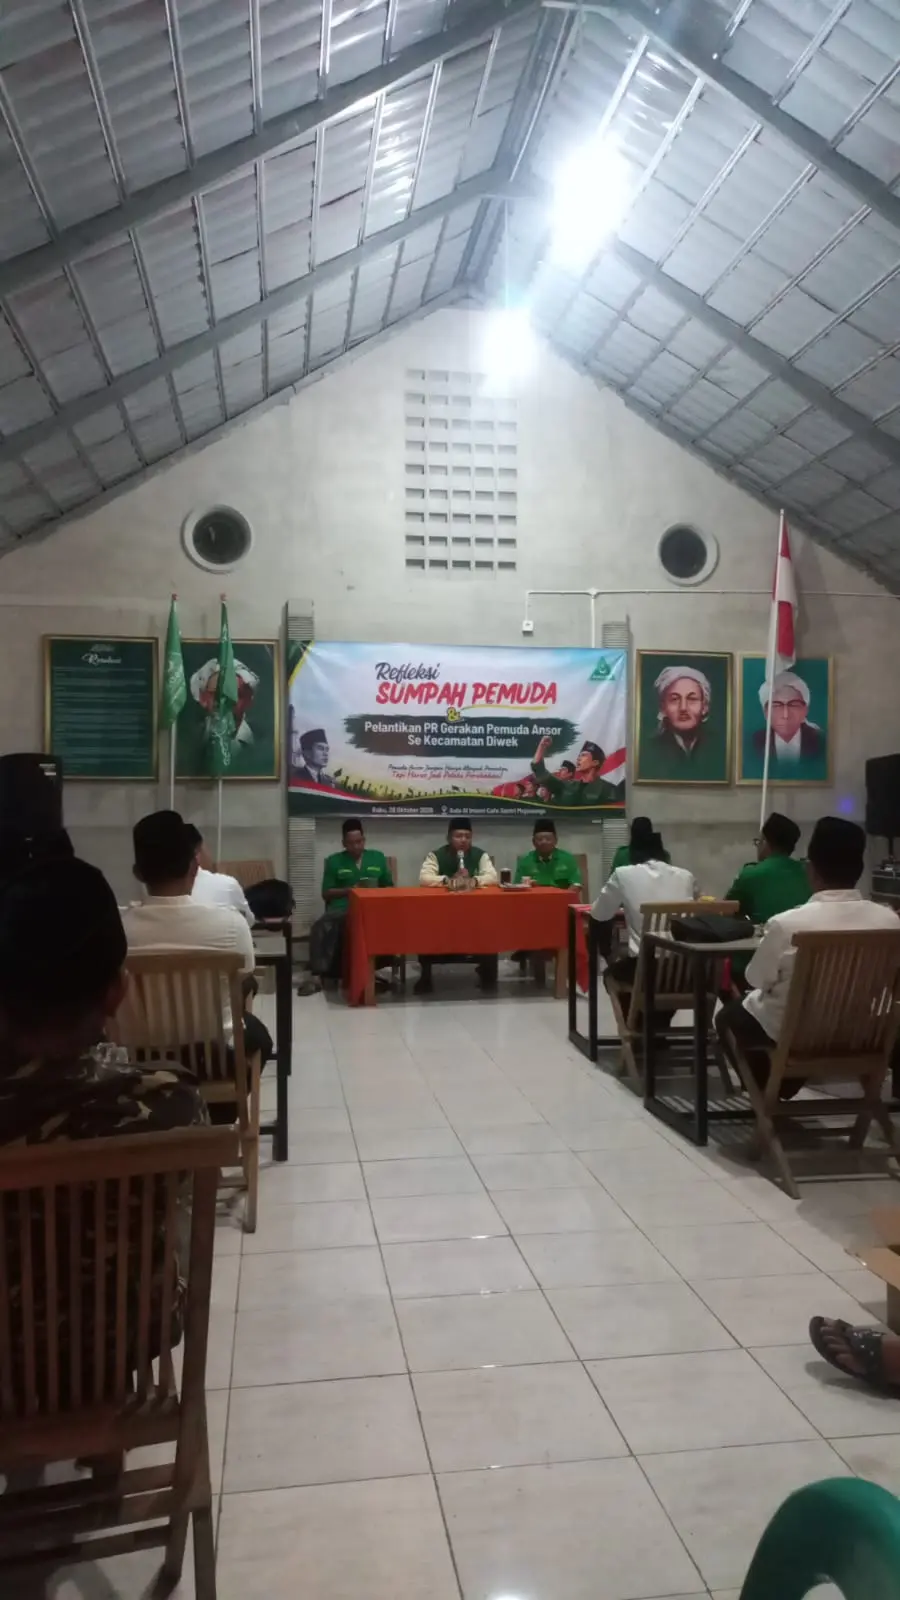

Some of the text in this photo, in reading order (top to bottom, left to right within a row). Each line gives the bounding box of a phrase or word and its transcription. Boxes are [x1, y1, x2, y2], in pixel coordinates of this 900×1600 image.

[375, 662, 440, 683] Refleksi
[375, 682, 557, 707] SUMPAH PEMUDA
[446, 707, 462, 722] &
[364, 721, 562, 736] Pelantikan PR Gerakan Pemuda Ansor
[407, 734, 518, 747] Se Kecamatan Diwek
